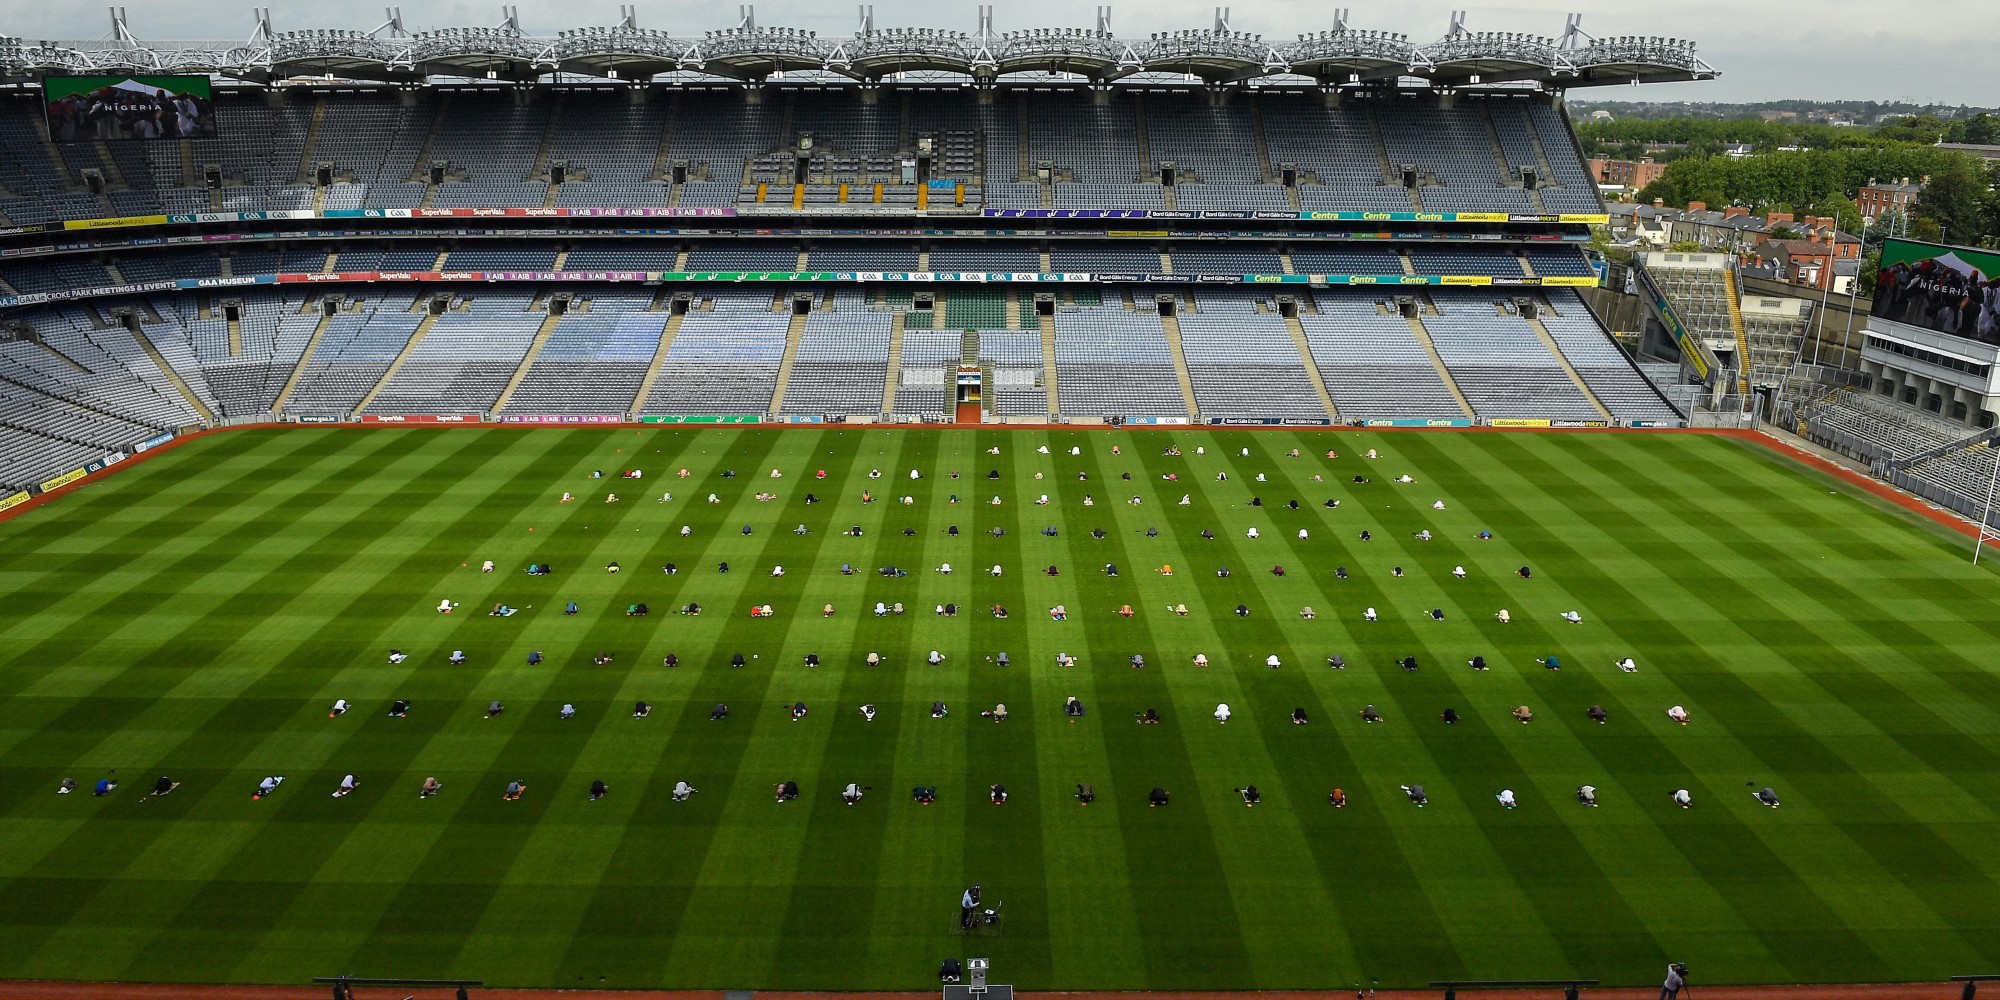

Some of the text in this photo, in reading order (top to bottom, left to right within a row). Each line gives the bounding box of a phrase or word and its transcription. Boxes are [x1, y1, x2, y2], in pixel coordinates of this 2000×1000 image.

[198, 277, 255, 287] GAA MUSEUM
[1920, 281, 1970, 297] NIGERIA
[47, 291, 70, 300] CROKE
[92, 285, 136, 295] MEETINGS
[144, 282, 176, 290] EVENTS
[1662, 306, 1678, 332] Centra
